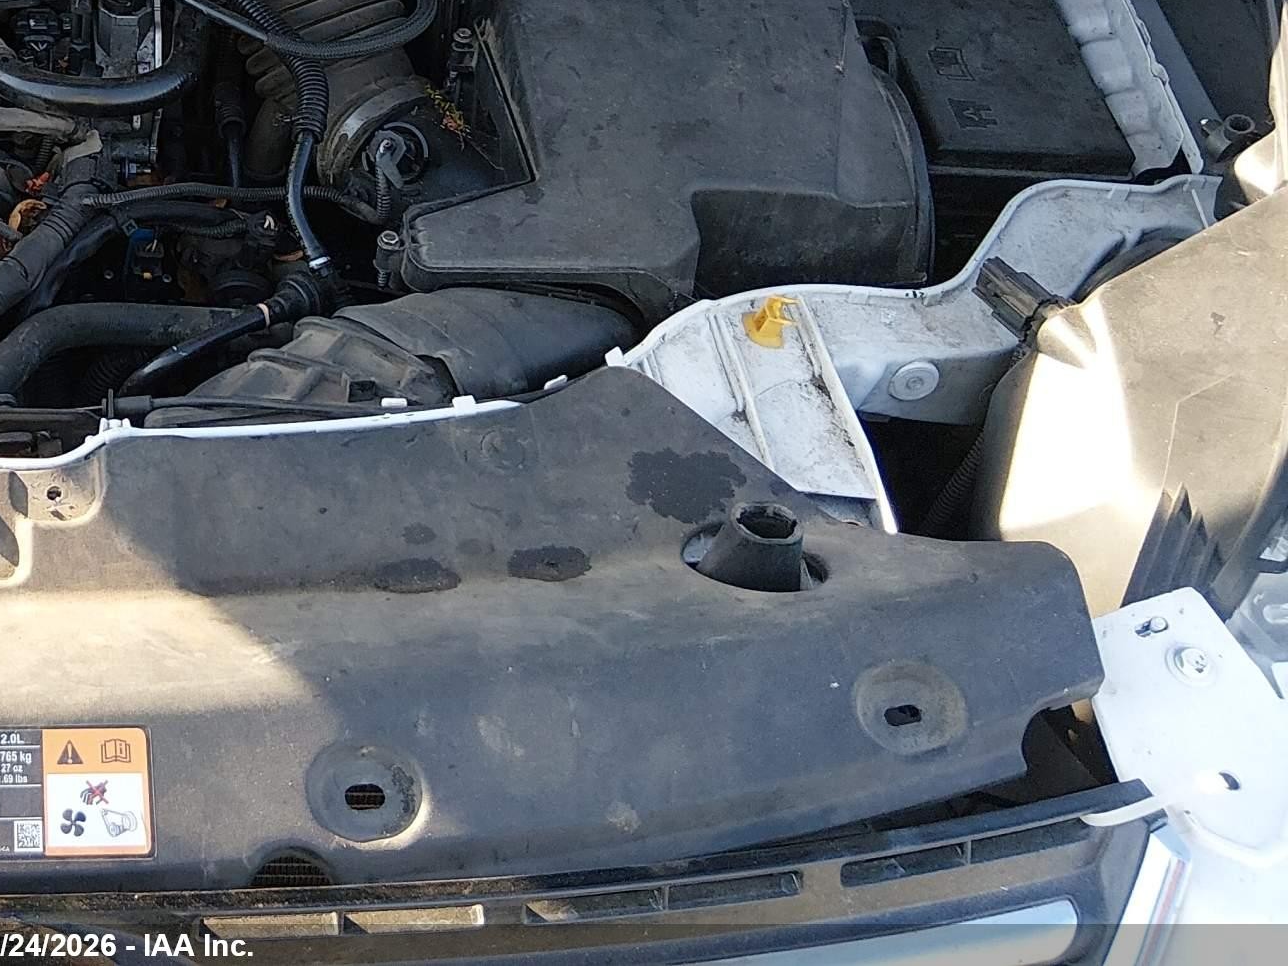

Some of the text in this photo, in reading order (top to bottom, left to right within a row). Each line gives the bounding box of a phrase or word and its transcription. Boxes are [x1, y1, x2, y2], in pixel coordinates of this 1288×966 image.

[0, 733, 25, 745] 2.0L
[19, 750, 32, 764] kg
[0, 763, 23, 773] 27 oz
[15, 774, 28, 783] lbs
